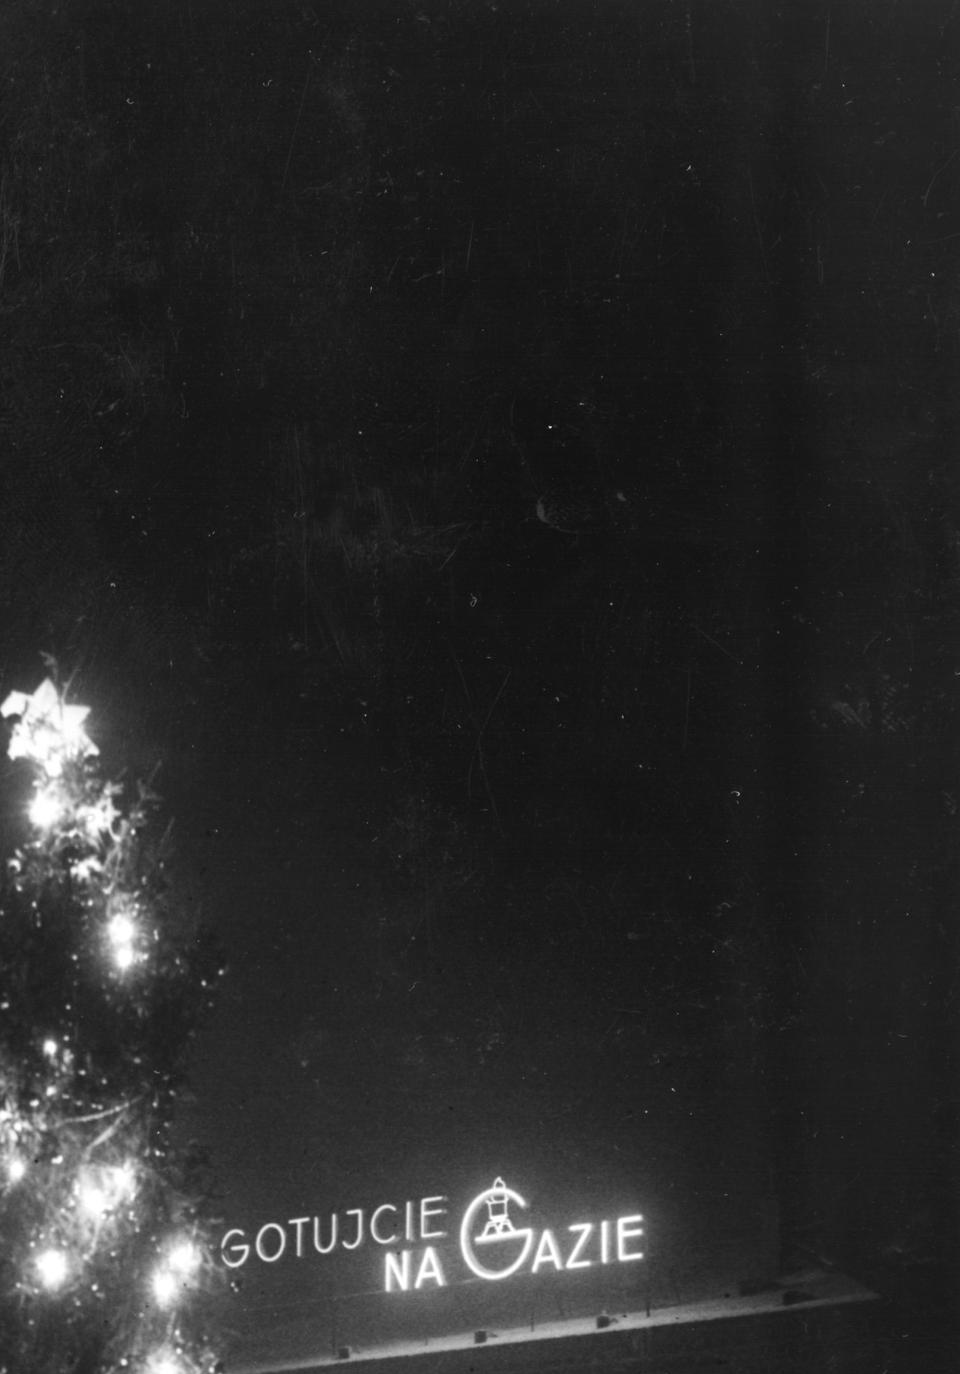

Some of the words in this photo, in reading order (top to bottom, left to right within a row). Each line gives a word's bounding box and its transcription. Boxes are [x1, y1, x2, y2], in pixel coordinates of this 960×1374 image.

[221, 1196, 448, 1269] GOTUJCIE
[385, 1246, 445, 1293] NA
[460, 1186, 645, 1281] GAZIE
